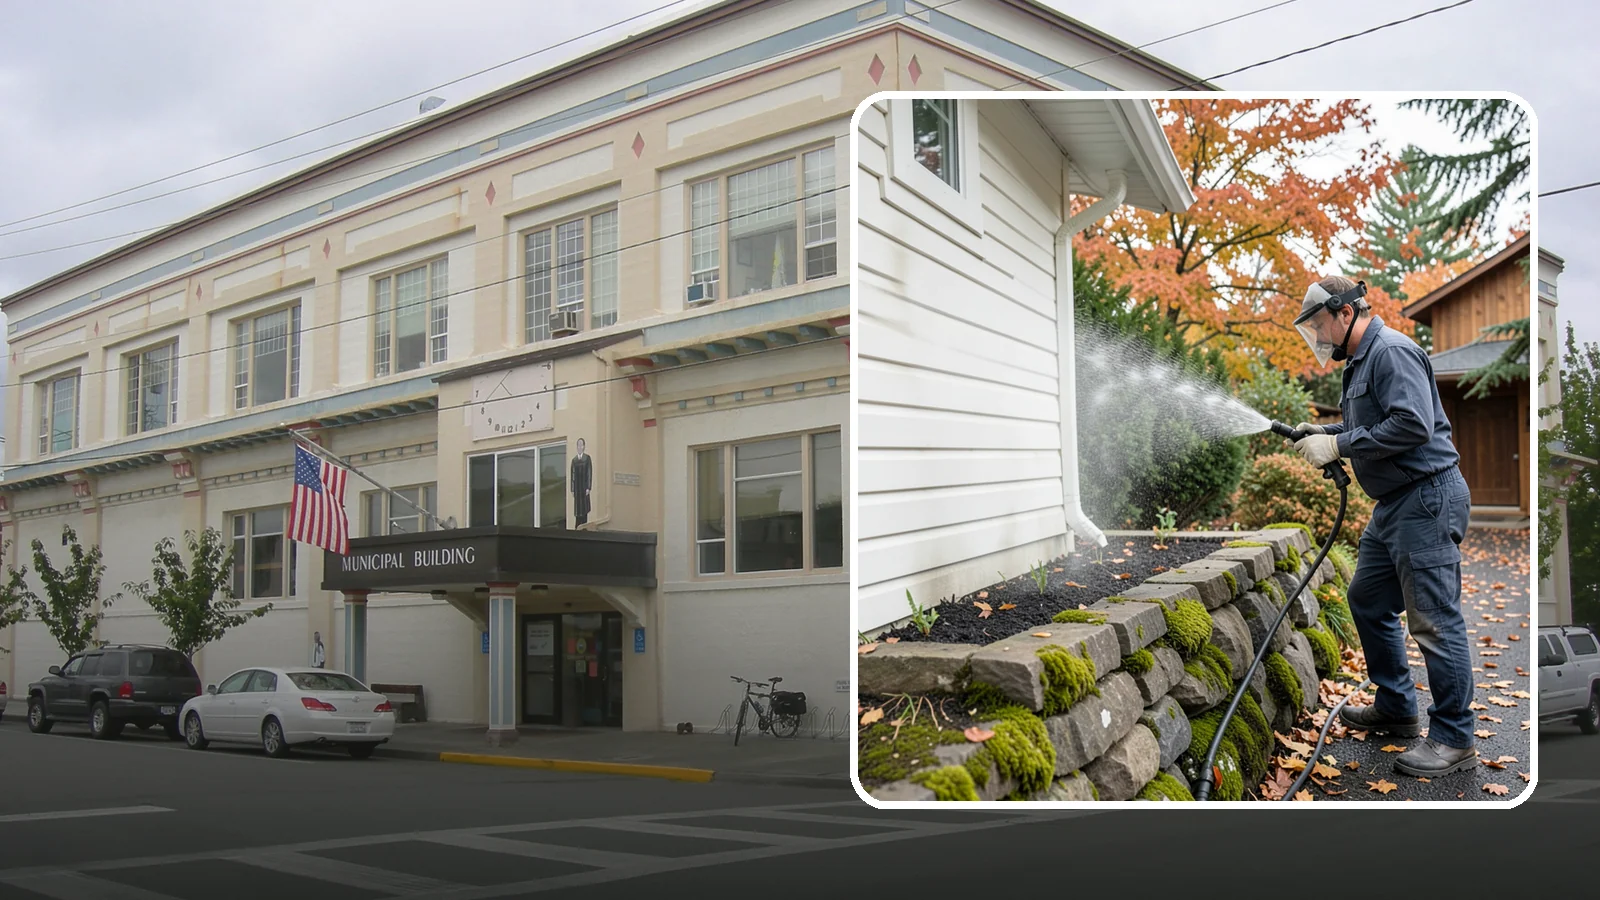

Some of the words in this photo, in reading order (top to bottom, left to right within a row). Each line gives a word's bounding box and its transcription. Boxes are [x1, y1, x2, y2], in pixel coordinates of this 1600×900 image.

[521, 420, 525, 428] 2
[342, 553, 405, 572] MUNICIPAL
[414, 546, 475, 566] BUILDING
